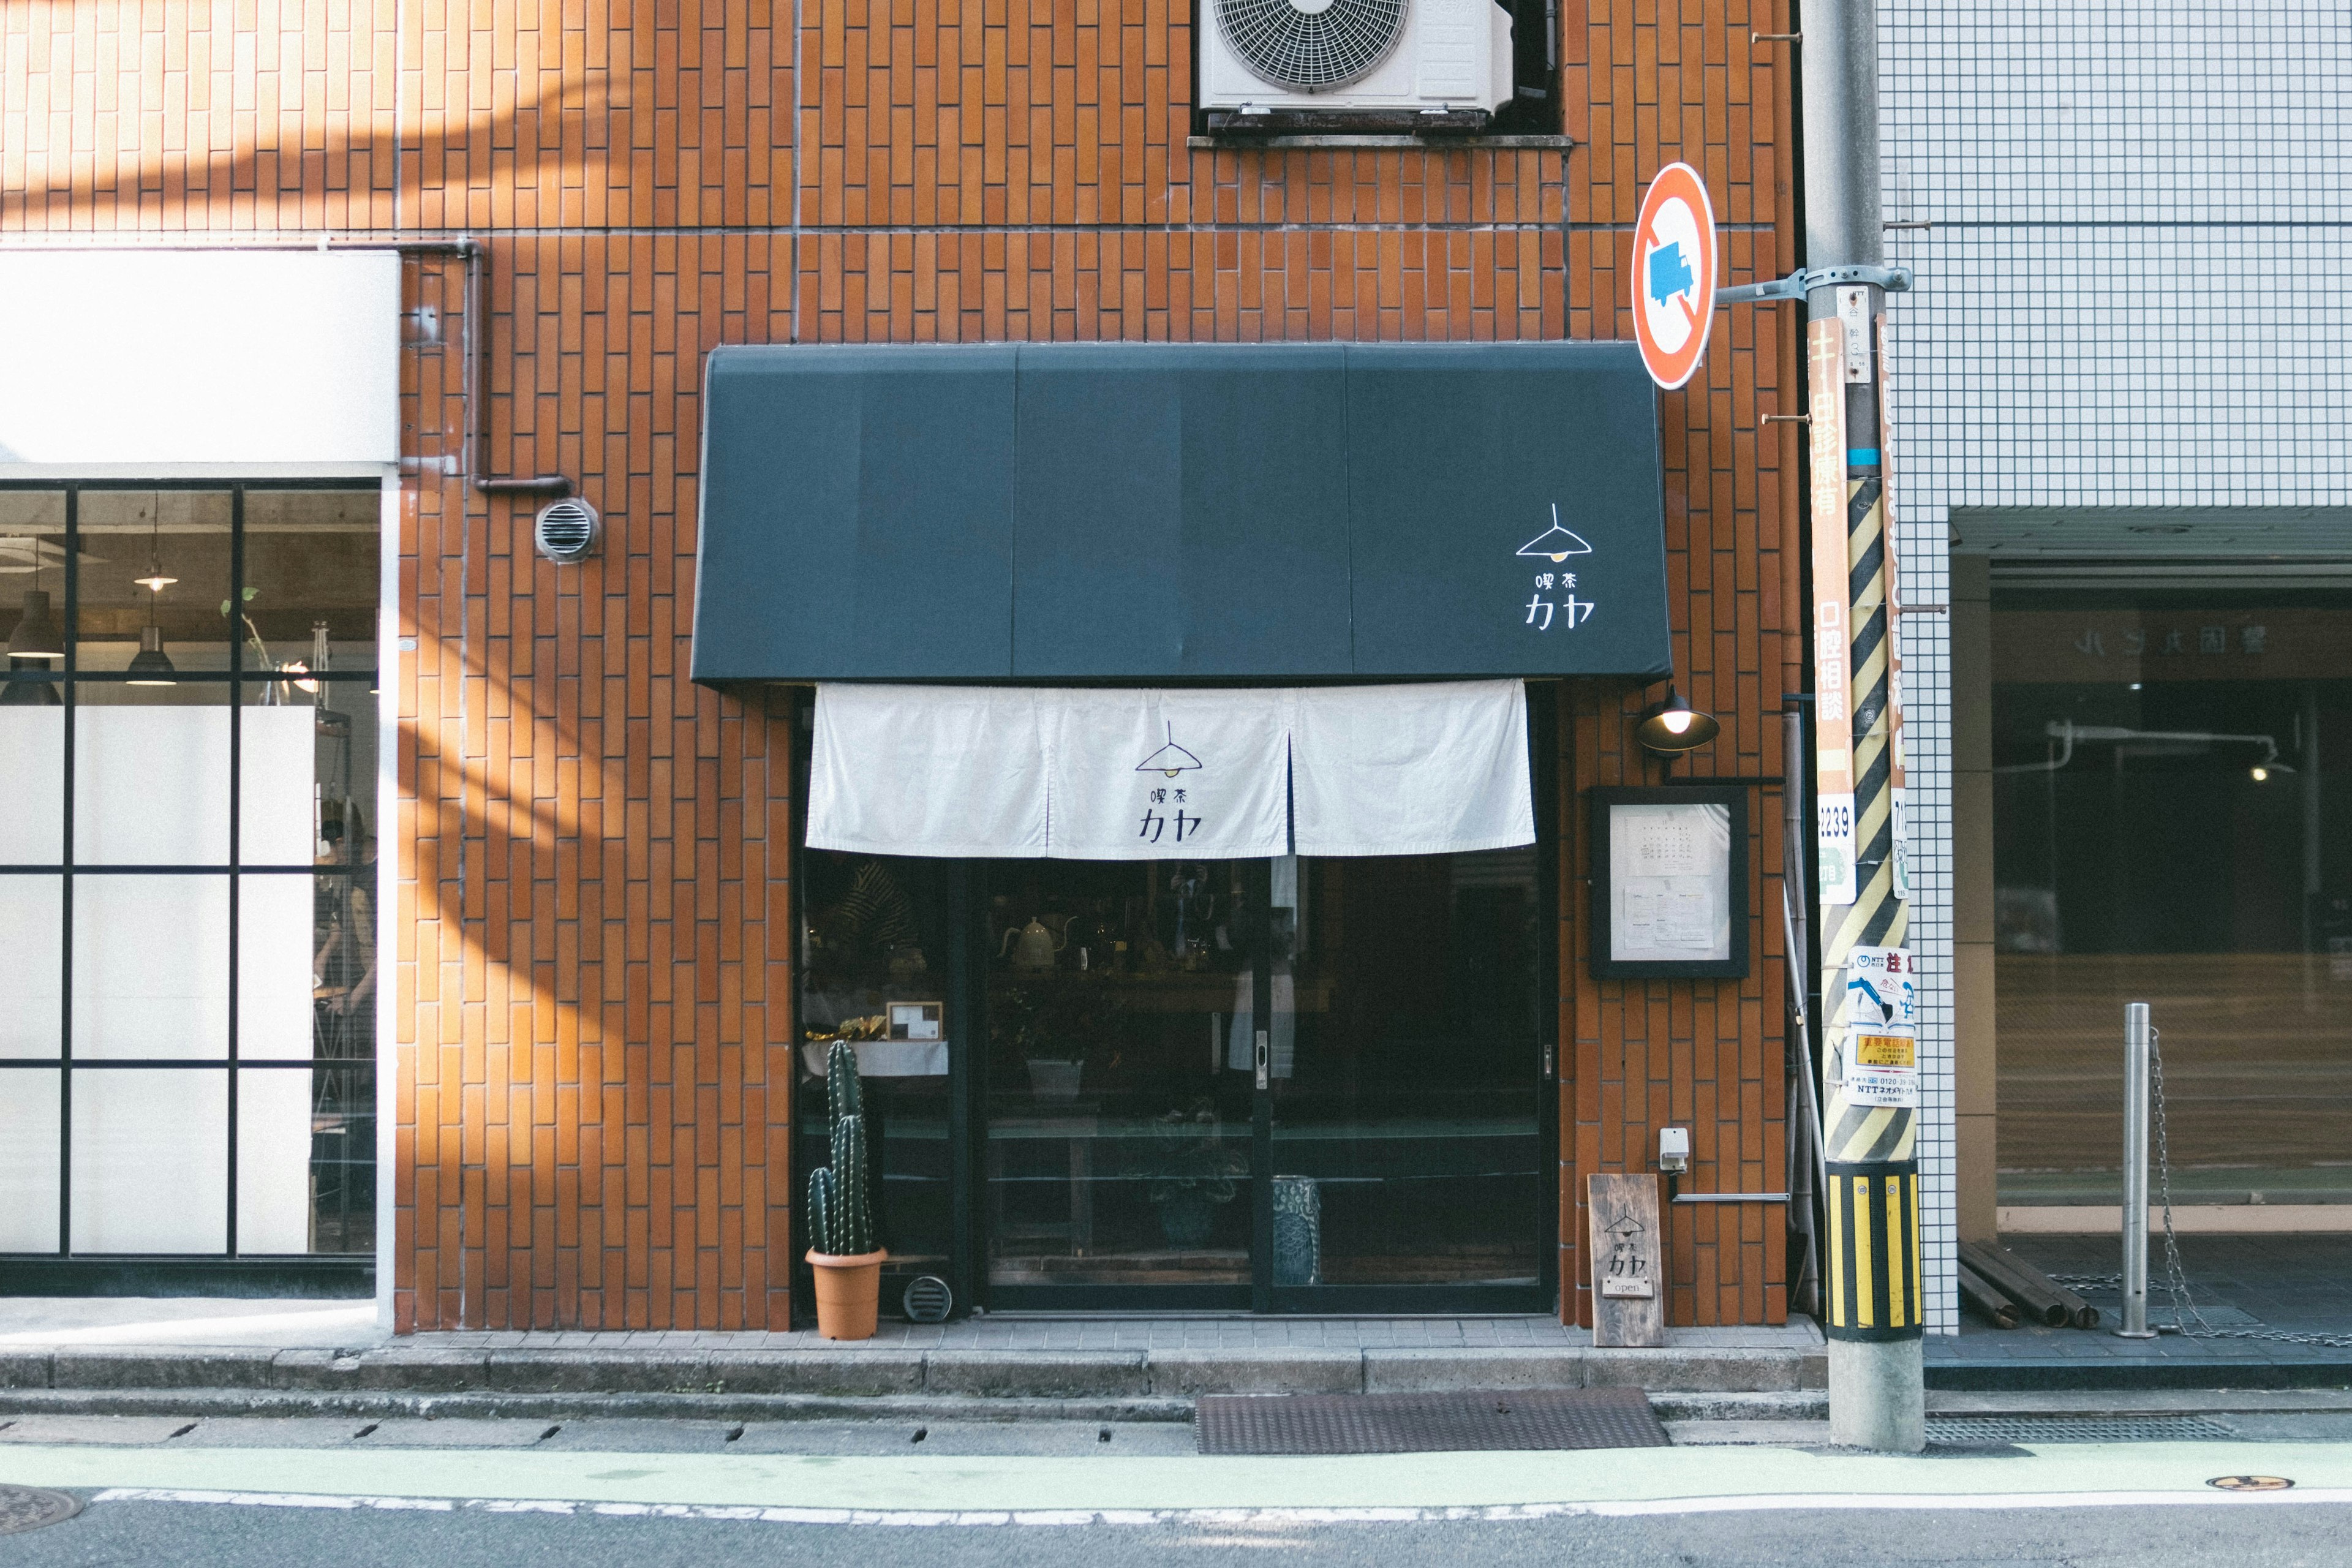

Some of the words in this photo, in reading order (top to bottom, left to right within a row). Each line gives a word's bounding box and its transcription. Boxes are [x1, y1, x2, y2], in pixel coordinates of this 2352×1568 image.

[1536, 573, 1577, 590] 喫茶
[1526, 594, 1594, 631] カヤ
[1820, 601, 1842, 720] 口腔相談
[1151, 788, 1187, 804] 喫茶
[1139, 809, 1201, 843] カヤ
[1614, 1243, 1637, 1253] 喫茶
[1609, 1254, 1646, 1276] カヤ
